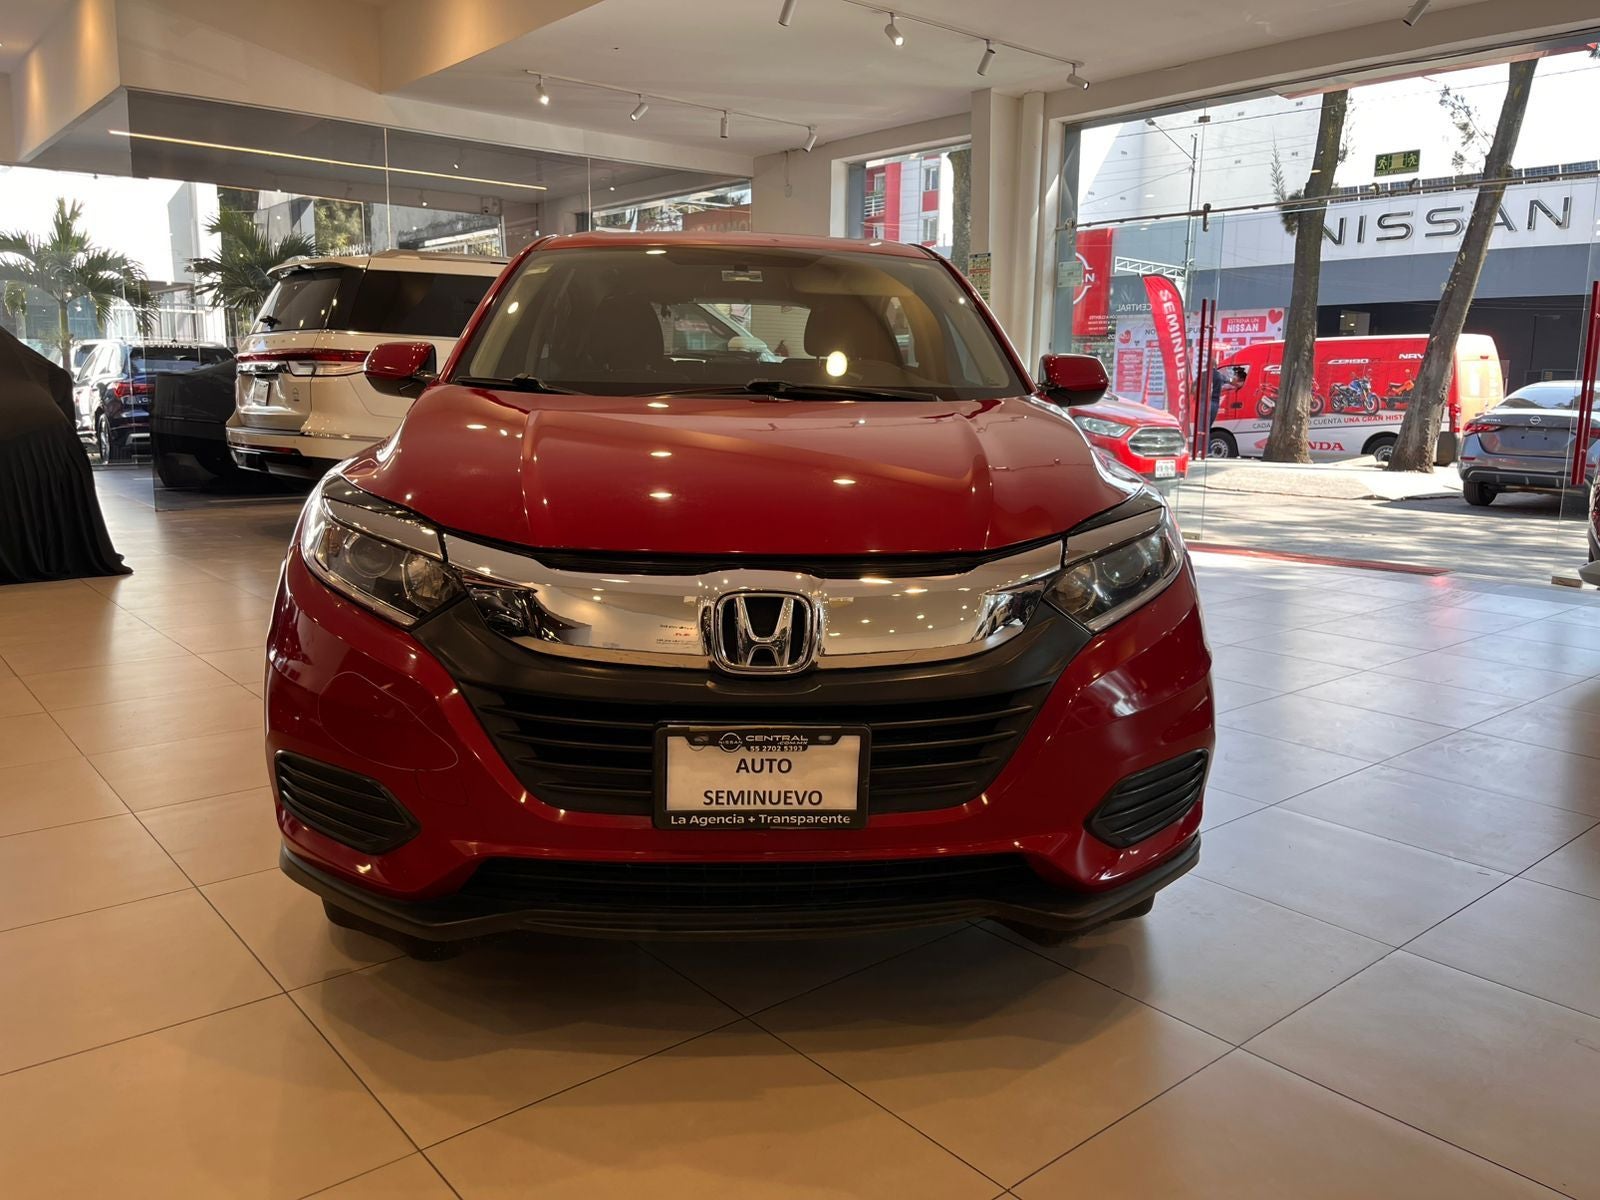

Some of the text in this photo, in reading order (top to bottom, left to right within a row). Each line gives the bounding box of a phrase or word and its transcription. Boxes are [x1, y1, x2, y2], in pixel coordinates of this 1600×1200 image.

[1226, 324, 1259, 333] NISSAN
[1308, 441, 1345, 451] NDA
[745, 734, 809, 742] CENTRAL
[735, 757, 792, 774] AUTO
[702, 789, 823, 806] SEMINUEVO
[670, 814, 686, 825] La
[689, 813, 745, 827] Agencia
[759, 813, 851, 826] Transparente
